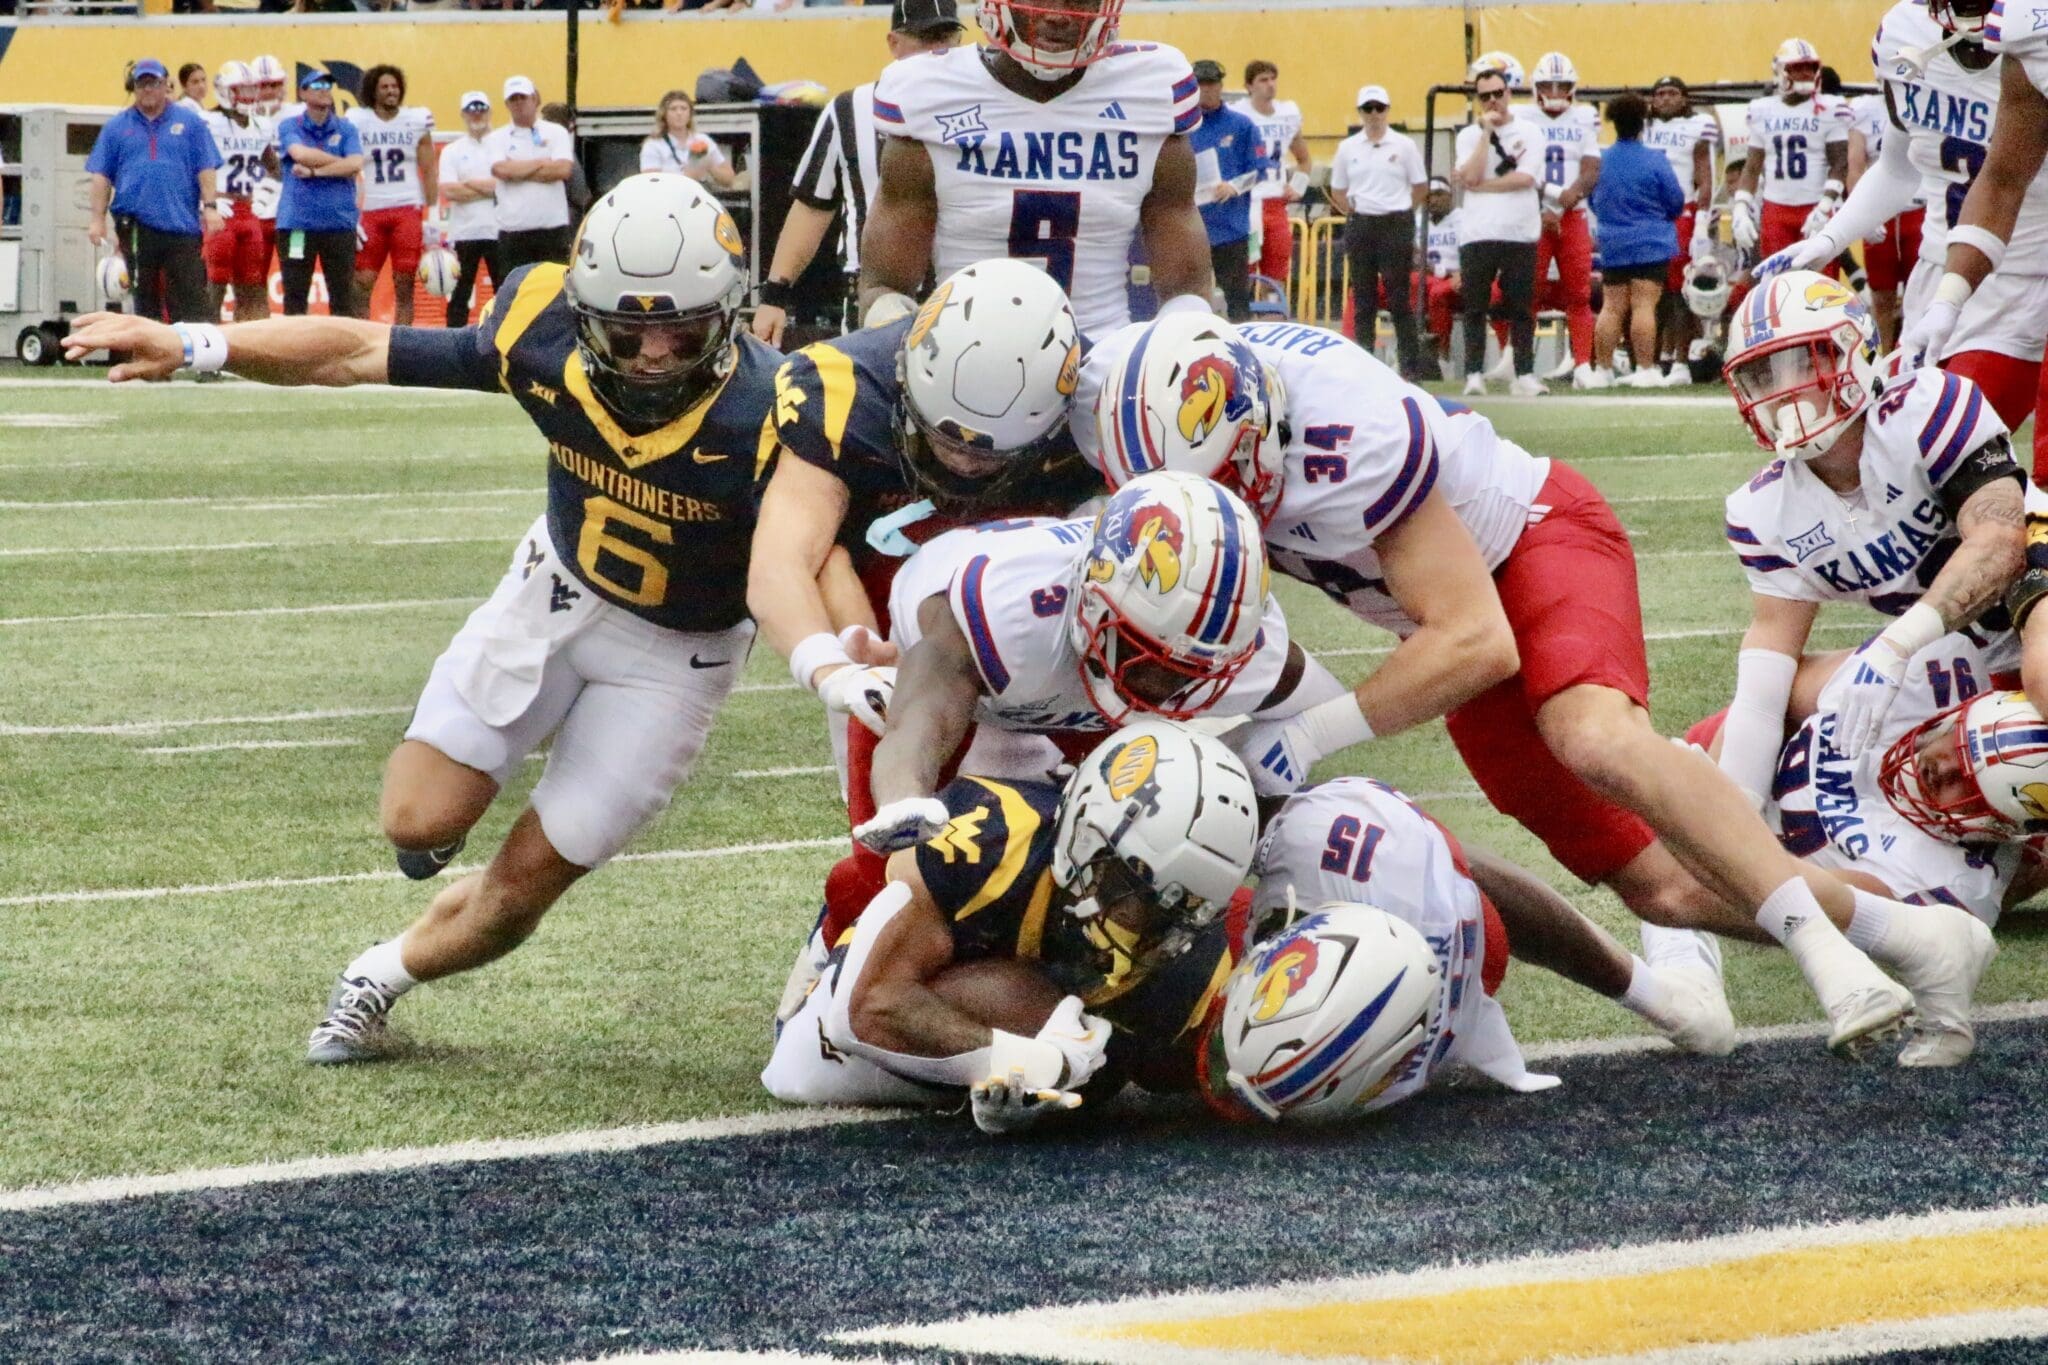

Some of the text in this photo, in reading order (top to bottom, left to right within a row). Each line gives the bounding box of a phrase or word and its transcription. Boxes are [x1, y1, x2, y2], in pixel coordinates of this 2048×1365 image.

[1764, 117, 1820, 134] KANSAS
[1902, 82, 1992, 145] KANS
[363, 131, 413, 146] KANSAS
[956, 131, 1139, 180] KANSAS
[1645, 126, 1687, 147] ANSAS
[1772, 135, 1808, 180] 16
[371, 148, 405, 184] 12
[1545, 145, 1565, 186] 8
[1237, 325, 1344, 356] RAIC
[1303, 423, 1354, 484] 34
[577, 495, 675, 608] 6
[1813, 498, 1948, 594] KANSAS
[1030, 584, 1068, 619] 3
[1111, 742, 1153, 788] WVU
[1320, 814, 1385, 883] 15
